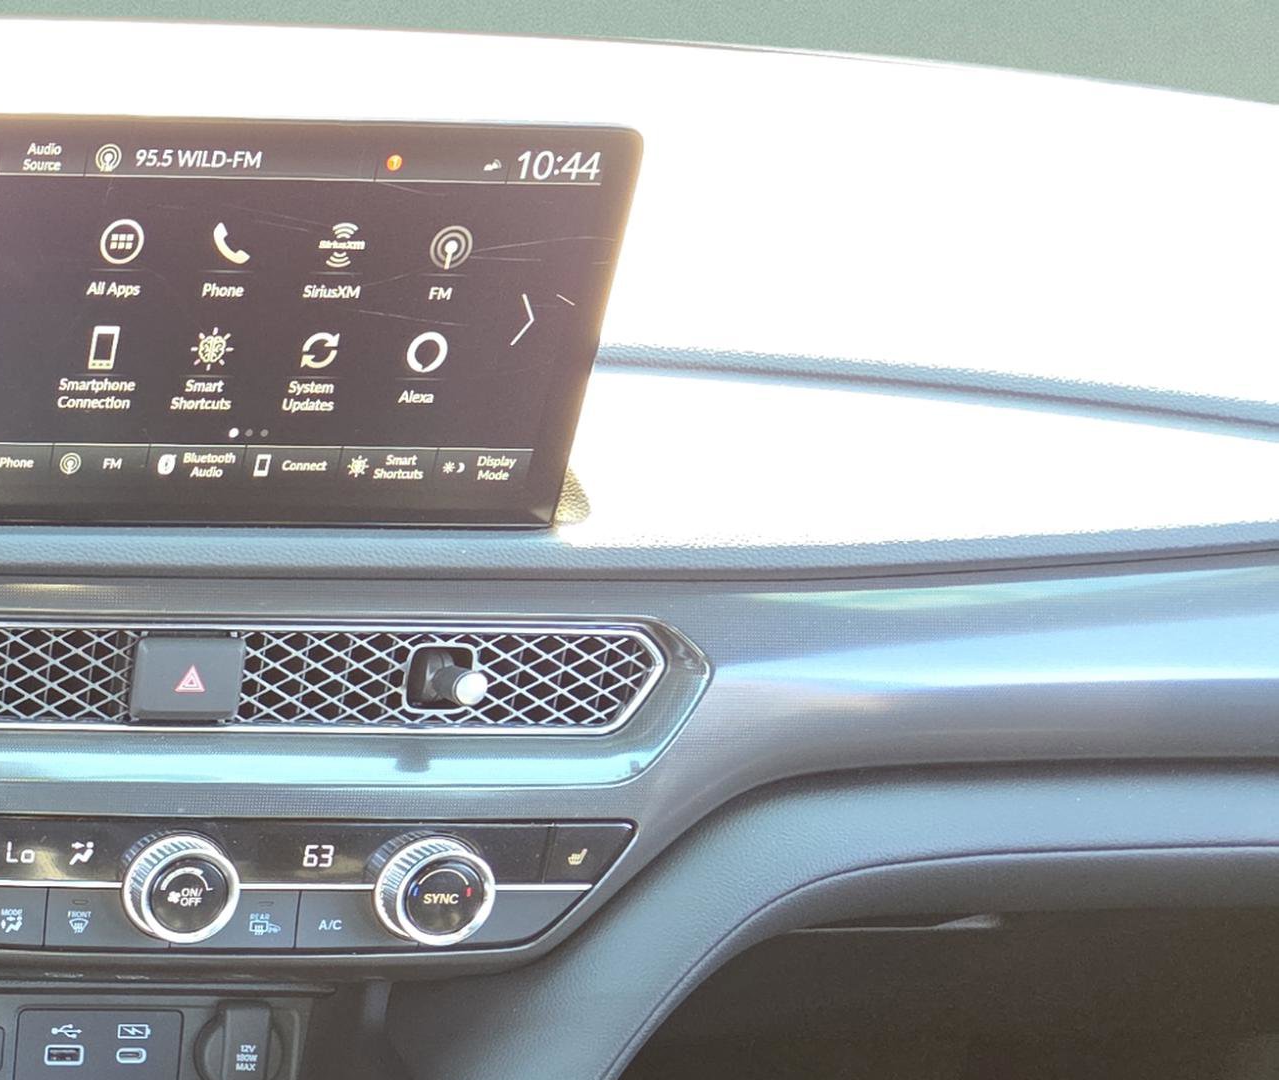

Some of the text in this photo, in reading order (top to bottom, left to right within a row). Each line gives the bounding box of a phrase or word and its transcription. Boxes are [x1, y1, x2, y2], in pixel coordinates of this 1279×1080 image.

[27, 143, 62, 155] Audio
[23, 158, 62, 171] Source
[135, 150, 263, 169] 95.5 WILD-FM
[516, 151, 601, 180] 10:44
[86, 282, 141, 298] All Apps
[202, 283, 245, 298] Phone
[302, 285, 361, 299] SiriusXM
[428, 287, 453, 300] FM
[58, 378, 136, 393] Smartphone
[185, 380, 224, 393] Smart
[287, 381, 334, 395] System
[57, 396, 131, 410] Connection
[170, 397, 232, 410] Shortcuts
[398, 390, 434, 404] Alexa
[282, 398, 334, 413] Updates
[103, 457, 123, 469] FM
[183, 452, 236, 464] Bluetooth
[385, 455, 417, 466] Smart
[476, 455, 517, 470] Display
[190, 466, 223, 478] Audio
[281, 459, 327, 472] Connect
[373, 468, 423, 480] Shortcuts
[476, 469, 510, 481] Mode
[302, 845, 335, 868] 63
[181, 888, 203, 897] ON/
[423, 893, 459, 905] SYNC
[180, 897, 202, 907] OFF
[318, 919, 342, 931] A/C
[241, 1044, 256, 1053] 12V
[236, 1063, 256, 1071] MAX
